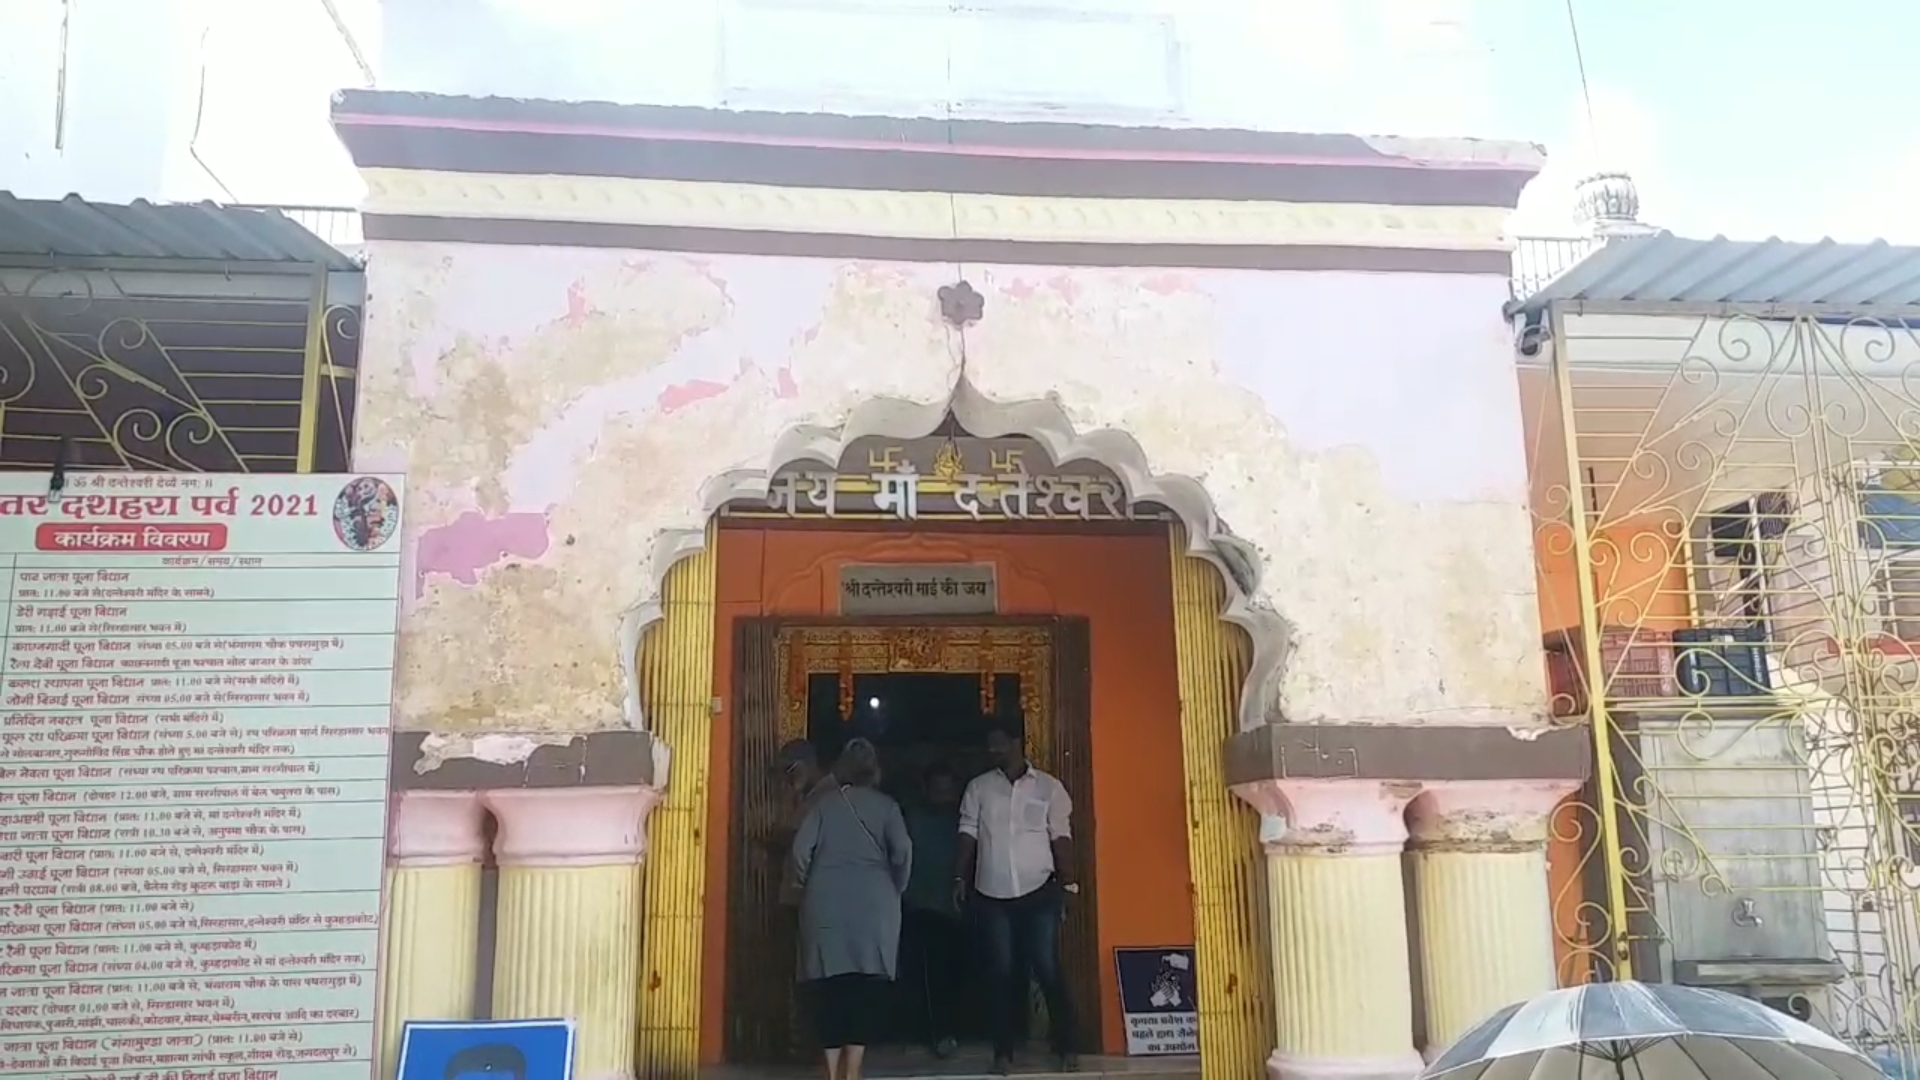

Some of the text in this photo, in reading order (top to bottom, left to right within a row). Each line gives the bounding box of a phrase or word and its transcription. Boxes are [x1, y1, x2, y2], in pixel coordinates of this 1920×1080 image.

[61, 494, 180, 520] दशहरा
[191, 487, 238, 516] पर्व
[250, 494, 318, 516] 2021
[768, 470, 838, 518] जय
[54, 526, 210, 548] कार्यक्रम विवरण
[916, 577, 938, 596] माई
[941, 577, 958, 596] की
